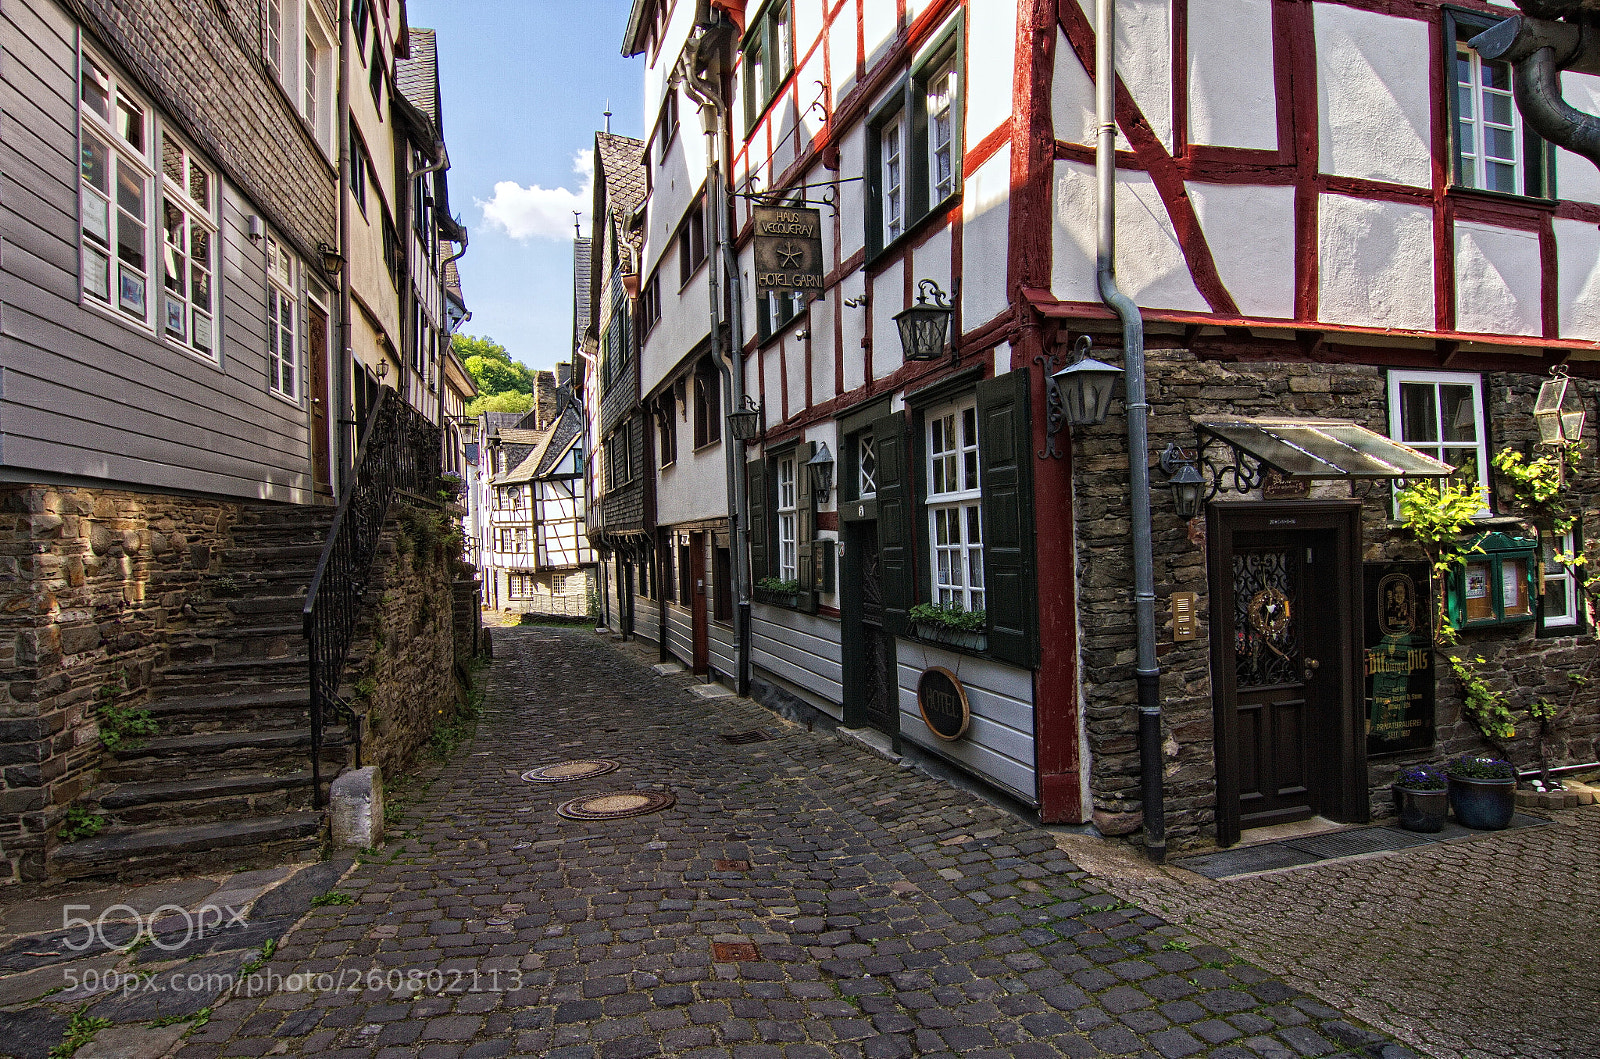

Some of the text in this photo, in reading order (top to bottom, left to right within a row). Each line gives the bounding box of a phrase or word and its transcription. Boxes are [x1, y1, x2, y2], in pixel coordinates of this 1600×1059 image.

[776, 211, 799, 223] HAUS
[759, 273, 823, 287] HOTEL GARNI
[926, 686, 959, 718] HOTEL
